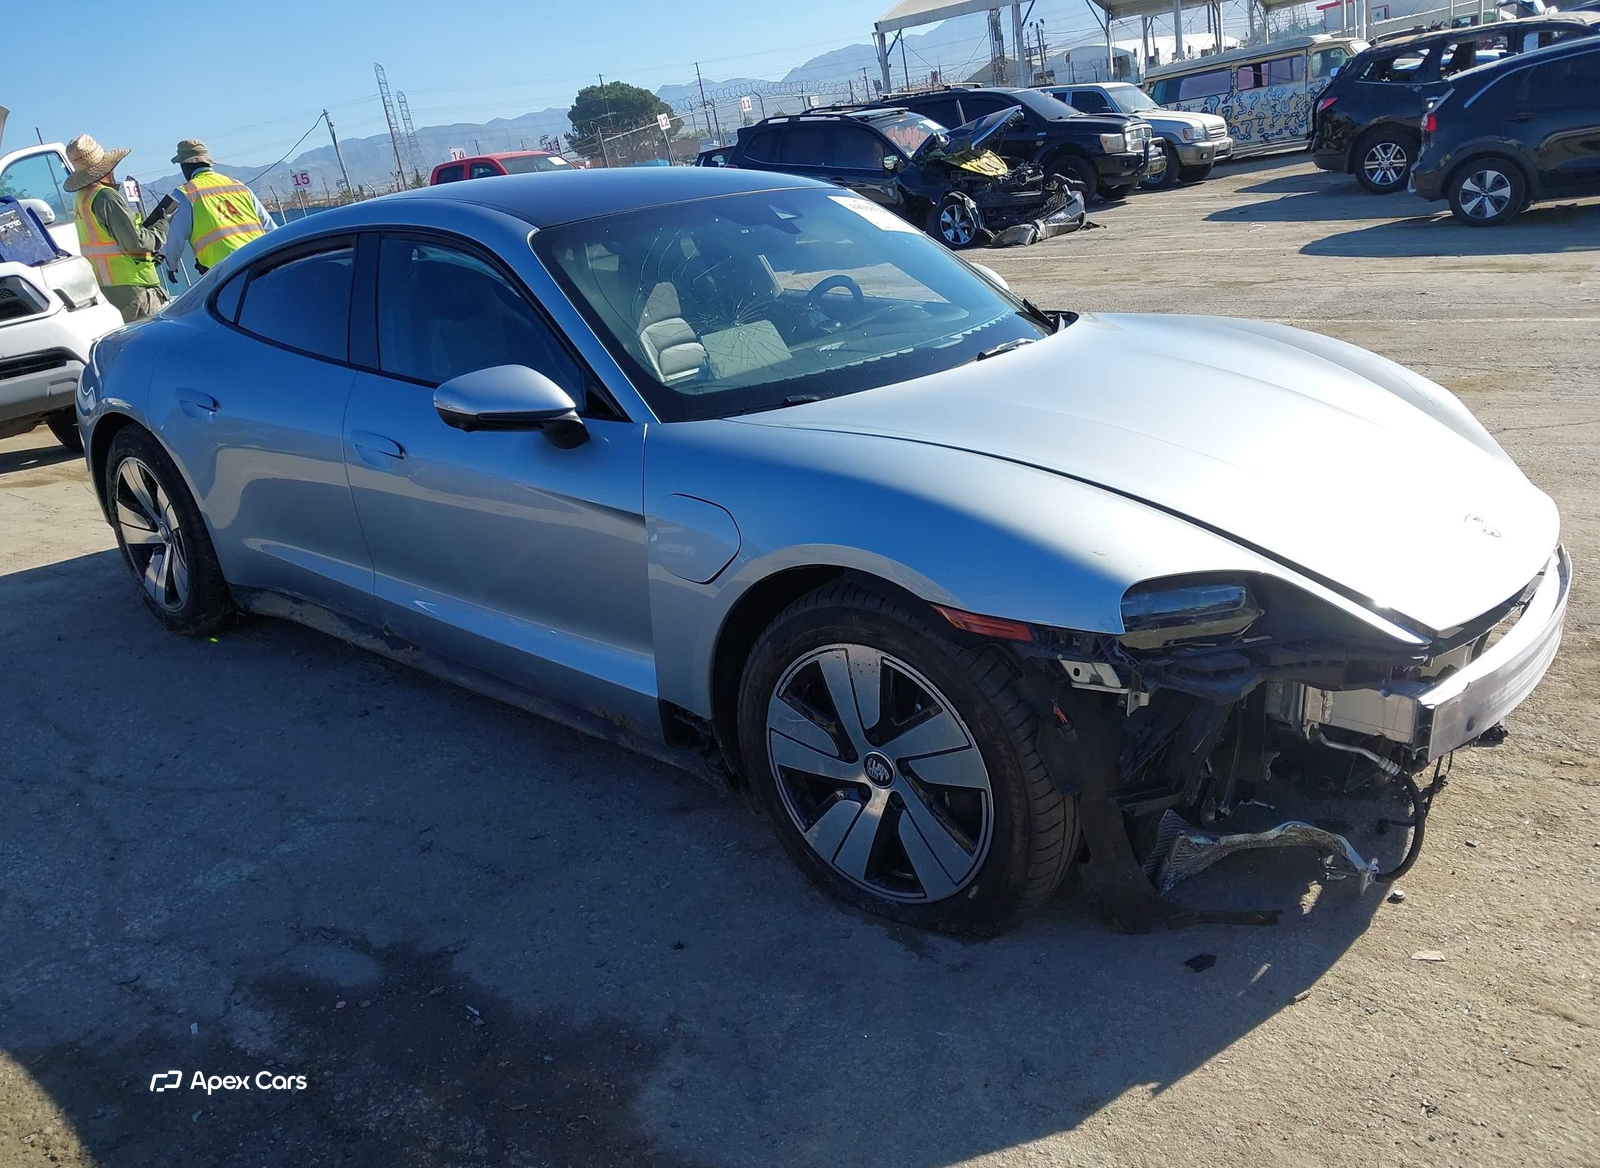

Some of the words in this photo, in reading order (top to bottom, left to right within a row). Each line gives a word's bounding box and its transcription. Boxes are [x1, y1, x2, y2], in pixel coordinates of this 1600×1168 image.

[742, 99, 751, 109] 11
[659, 116, 669, 128] 12
[547, 140, 560, 151] 13
[451, 150, 466, 160] 14
[291, 172, 310, 186] 15
[126, 185, 141, 198] 16
